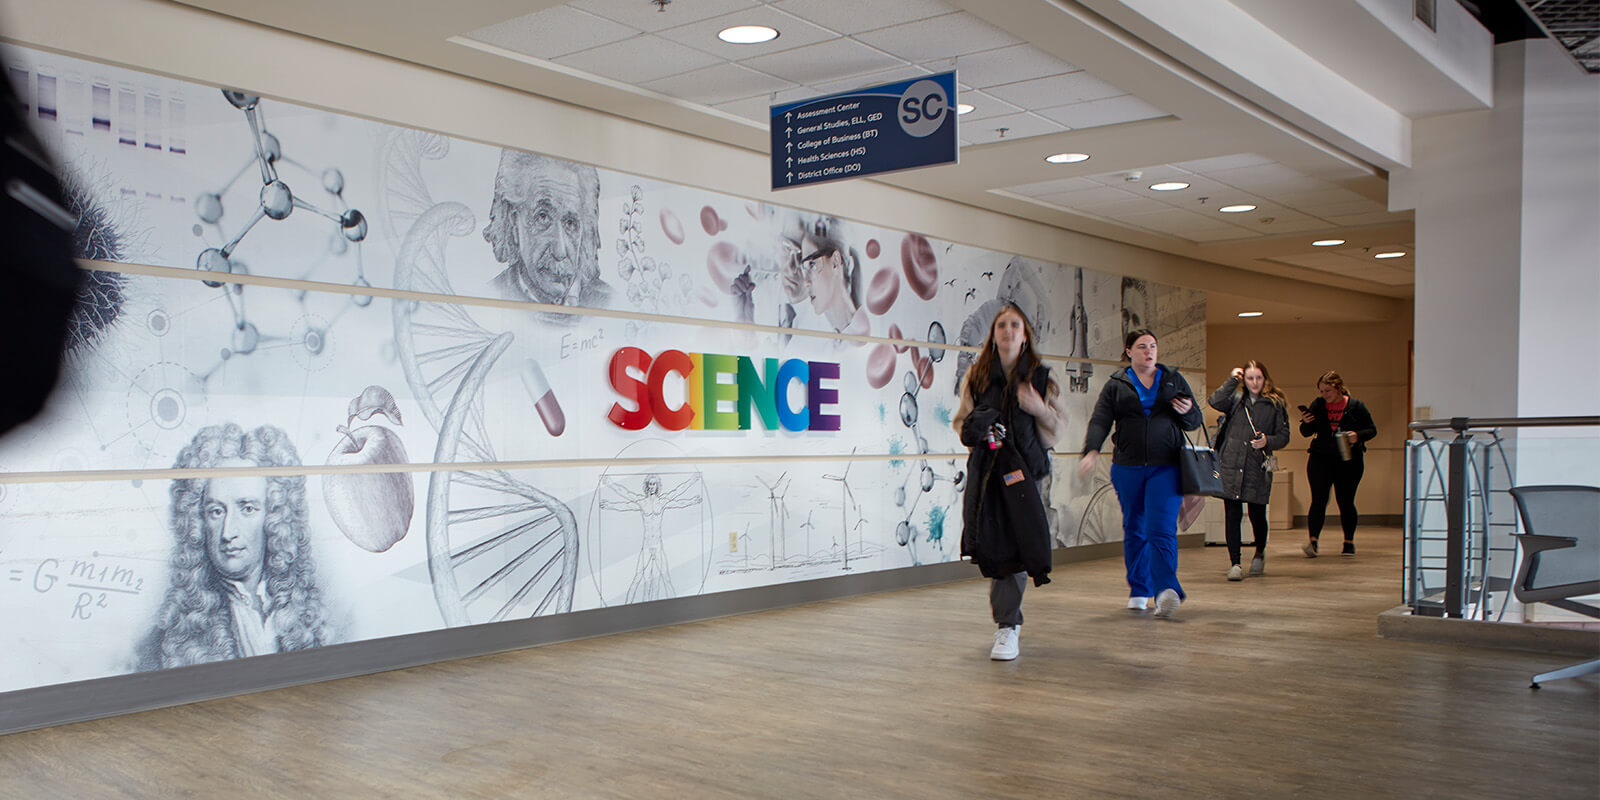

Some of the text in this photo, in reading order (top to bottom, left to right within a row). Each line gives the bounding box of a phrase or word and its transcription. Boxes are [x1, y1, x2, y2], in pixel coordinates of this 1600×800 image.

[797, 102, 860, 119] Assessment Center
[902, 93, 943, 123] SC
[797, 112, 883, 134] General Studies, ELL, GED
[797, 129, 878, 149] College of Business (BT)
[797, 146, 866, 165] Health Sciences (HS)
[798, 163, 861, 179] District Office (DO)
[608, 346, 841, 432] SCIENCE
[33, 558, 59, 593] G
